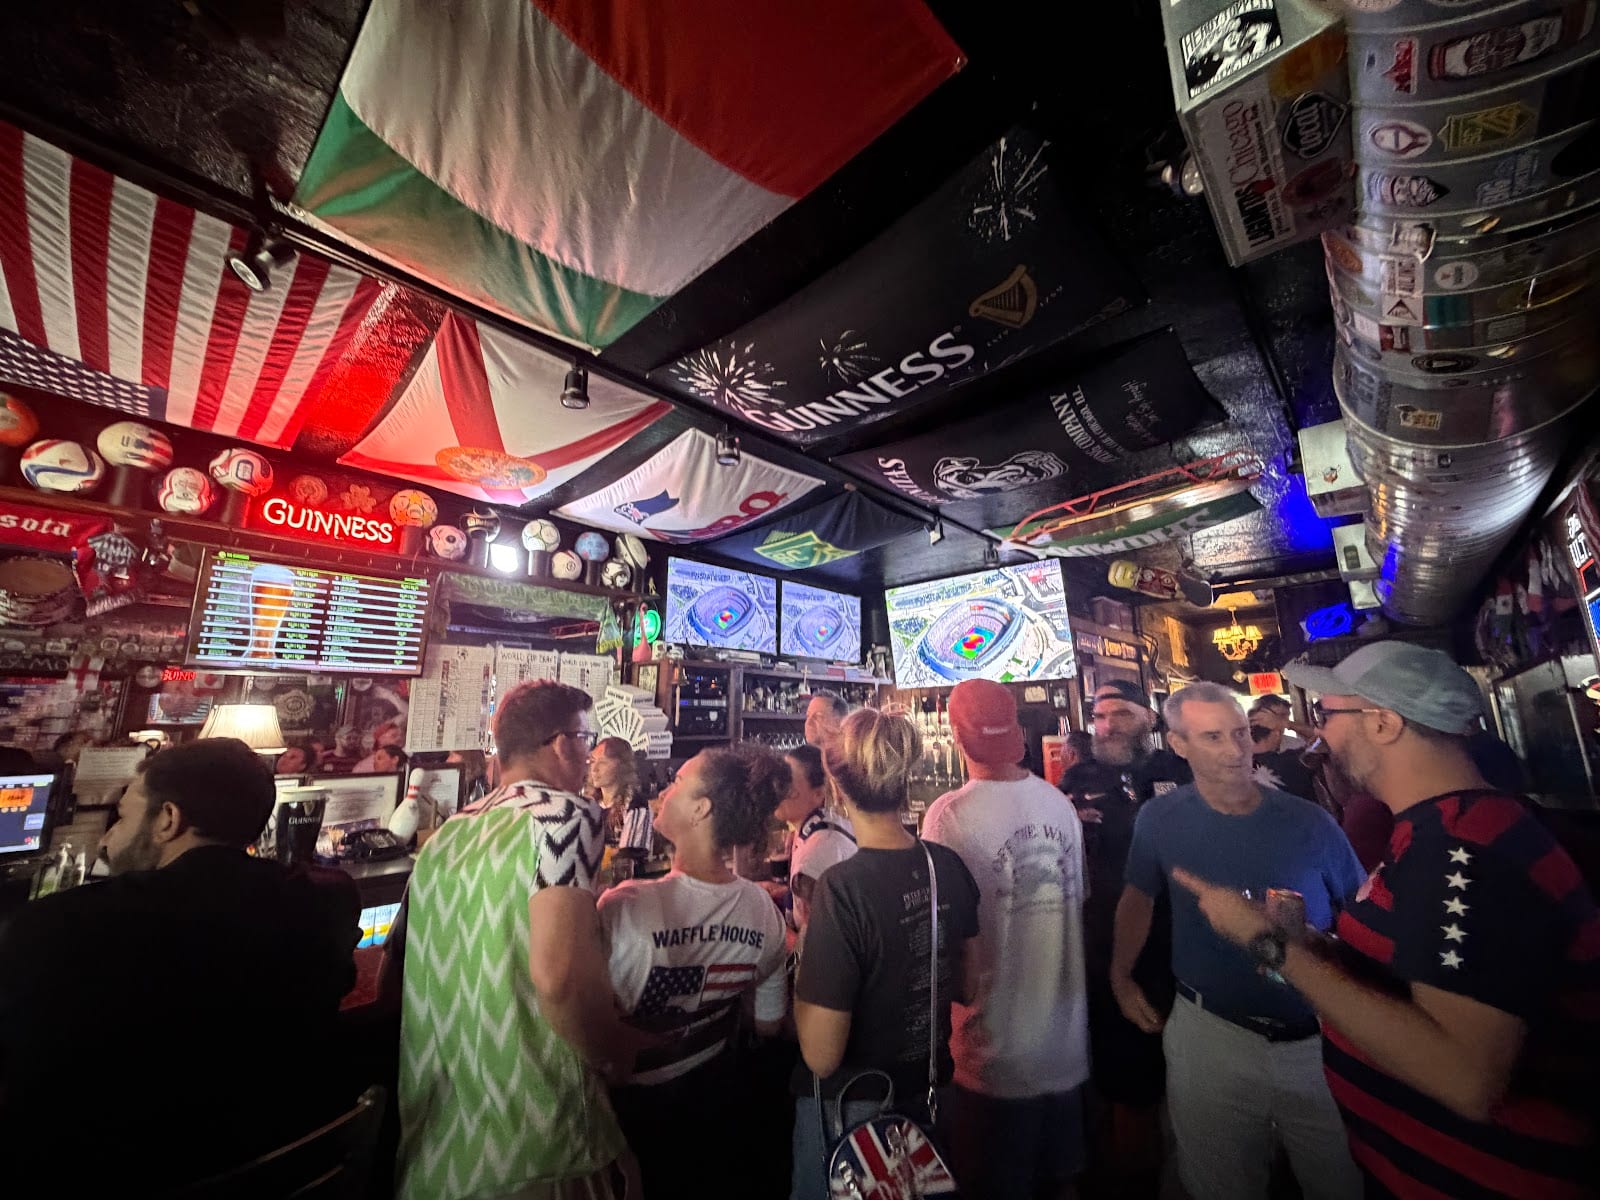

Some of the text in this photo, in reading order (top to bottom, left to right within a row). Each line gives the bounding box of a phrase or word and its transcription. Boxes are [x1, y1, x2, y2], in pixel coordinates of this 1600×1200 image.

[744, 331, 975, 432] GUINNESS
[1049, 392, 1095, 450] COMPANY
[264, 498, 393, 544] GUINNESS
[652, 924, 765, 949] WAFFLE HOUSE
